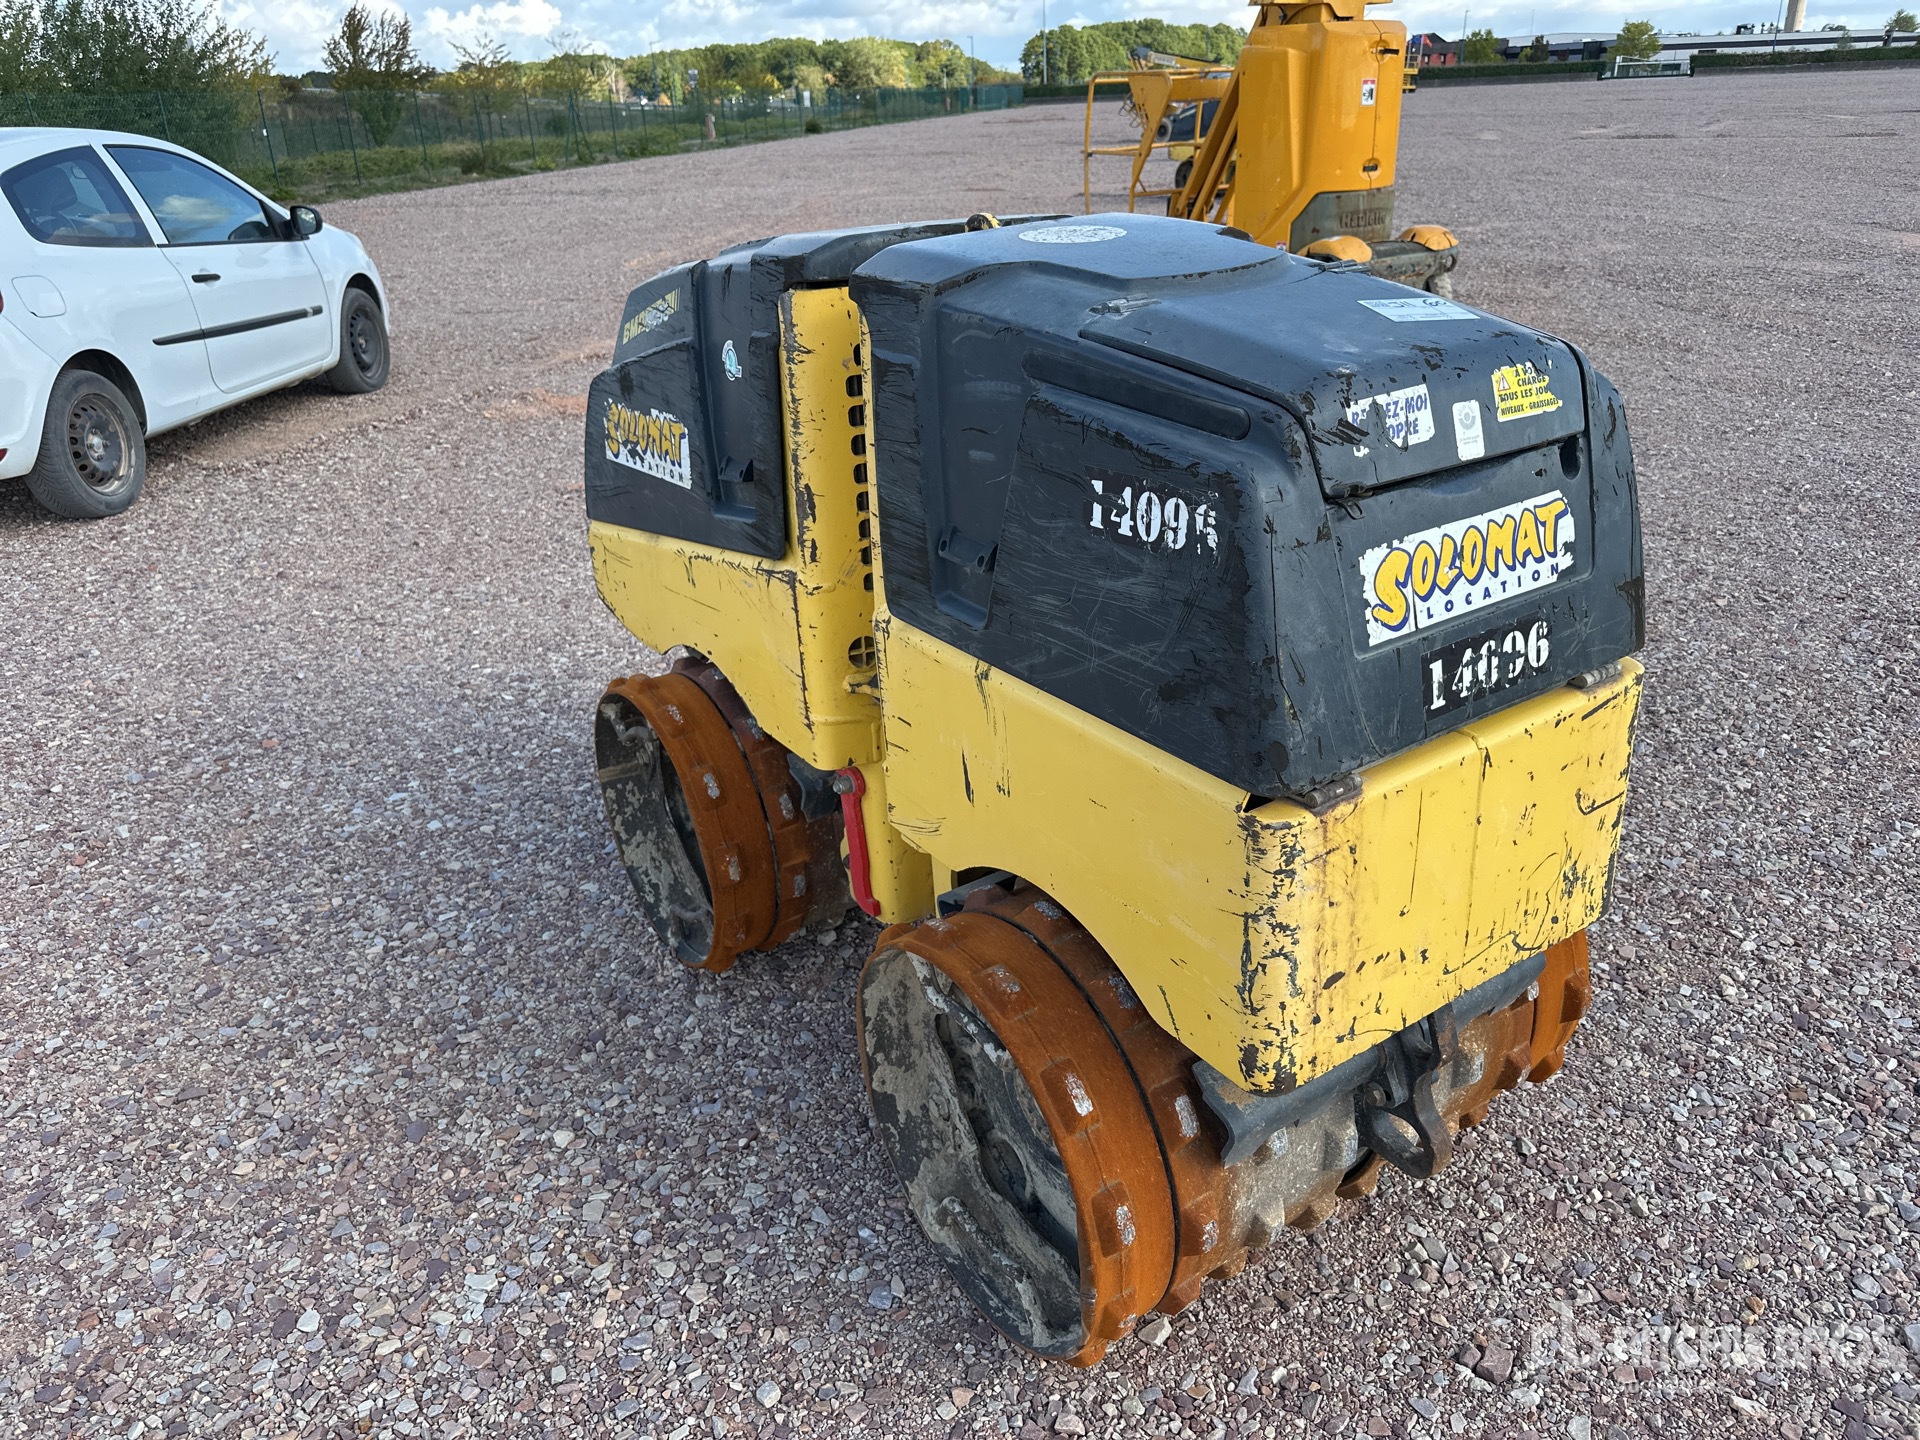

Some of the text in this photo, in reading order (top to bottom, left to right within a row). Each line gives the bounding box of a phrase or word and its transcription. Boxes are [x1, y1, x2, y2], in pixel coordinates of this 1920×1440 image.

[1499, 392, 1519, 403] TOUS
[1521, 388, 1533, 398] LES
[1501, 404, 1525, 416] NIVEAUX
[1529, 397, 1559, 410] GRAISSAGES
[1517, 375, 1546, 387] CHARGE
[607, 403, 687, 469] SOLOMAT
[1371, 498, 1569, 632] SOLOMAT
[1427, 562, 1559, 620] LOCATION
[1429, 621, 1550, 710] 14096
